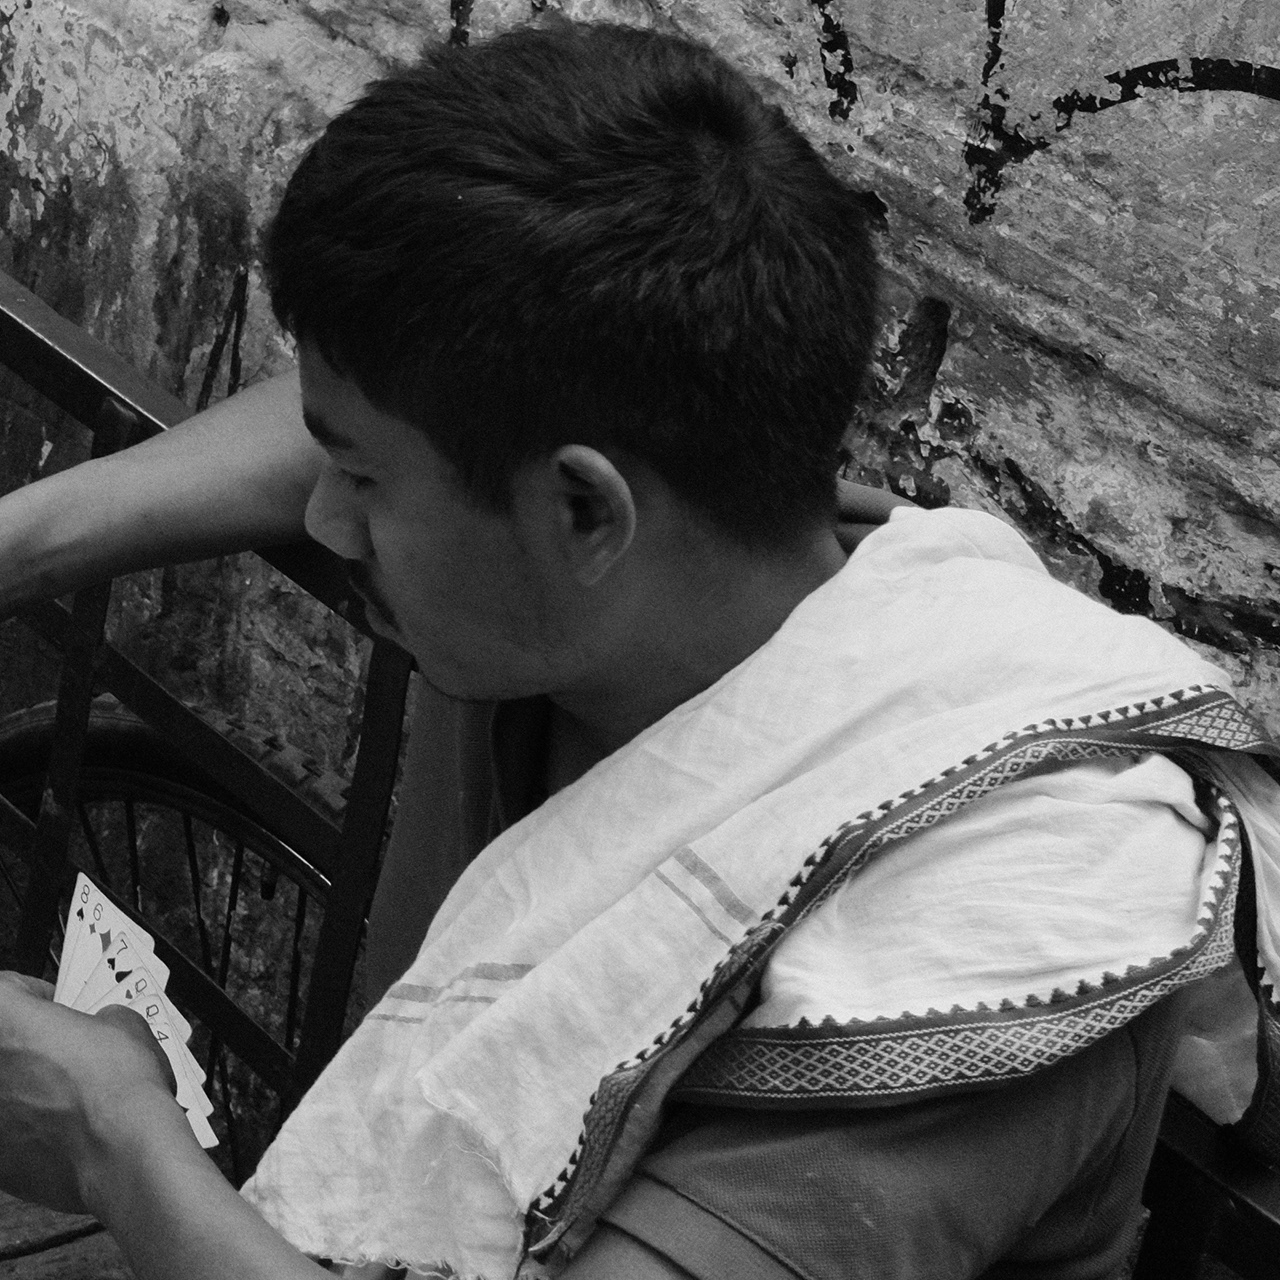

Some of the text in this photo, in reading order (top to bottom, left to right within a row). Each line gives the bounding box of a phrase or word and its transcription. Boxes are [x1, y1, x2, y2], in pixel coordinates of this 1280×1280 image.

[80, 884, 91, 904] 8
[92, 902, 104, 921] 6
[116, 938, 129, 956] 7
[145, 1003, 160, 1019] Q
[156, 1030, 170, 1044] 4
